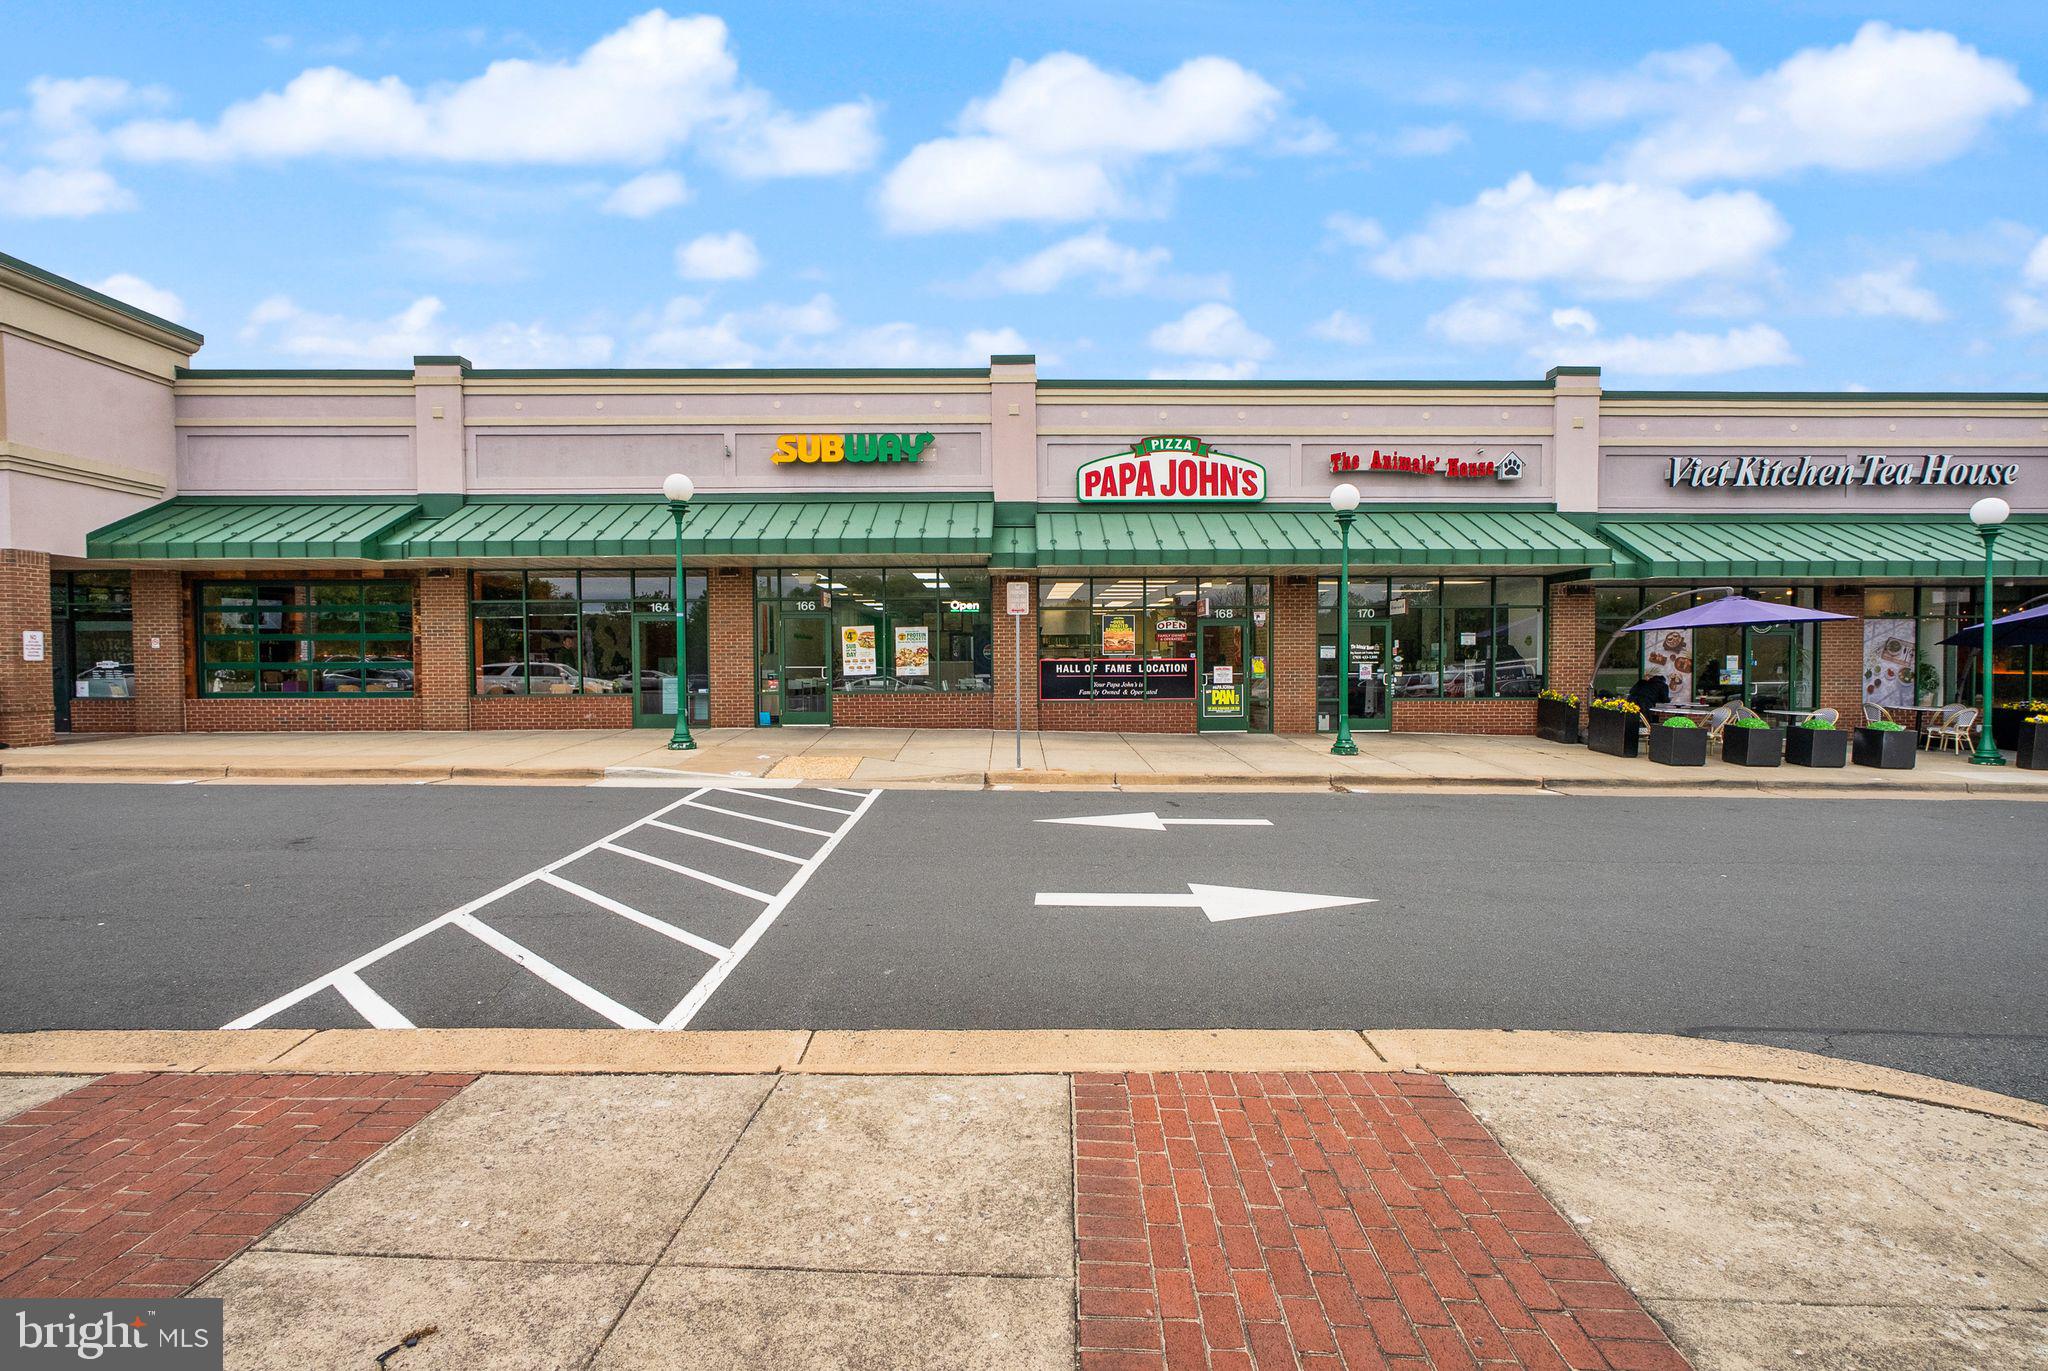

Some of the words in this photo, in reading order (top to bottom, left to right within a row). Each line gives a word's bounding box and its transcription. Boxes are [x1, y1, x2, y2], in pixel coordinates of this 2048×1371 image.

[769, 431, 936, 464] SUBWAY
[1151, 438, 1192, 450] PIZZA
[1330, 451, 1360, 473] The
[1370, 450, 1440, 475] Animals'
[1446, 457, 1496, 477] House
[1668, 456, 1731, 488] Viet
[1732, 455, 1855, 488] Kitchen
[1859, 454, 1914, 486] Tea
[1918, 454, 2020, 486] House
[1085, 460, 1156, 497] PAPA
[1160, 459, 1258, 497] JOHN'S
[649, 602, 670, 613] 164
[796, 601, 816, 611] 166
[950, 600, 980, 611] Open
[1214, 608, 1233, 619] 168
[1357, 608, 1375, 618] 170
[1157, 621, 1186, 629] OPEN
[1056, 664, 1081, 673] HALL
[1084, 664, 1098, 673] OF
[1105, 664, 1132, 673] FAME
[1138, 663, 1188, 673] LOCATION
[1106, 681, 1120, 689] Papa
[1211, 689, 1236, 705] PAN
